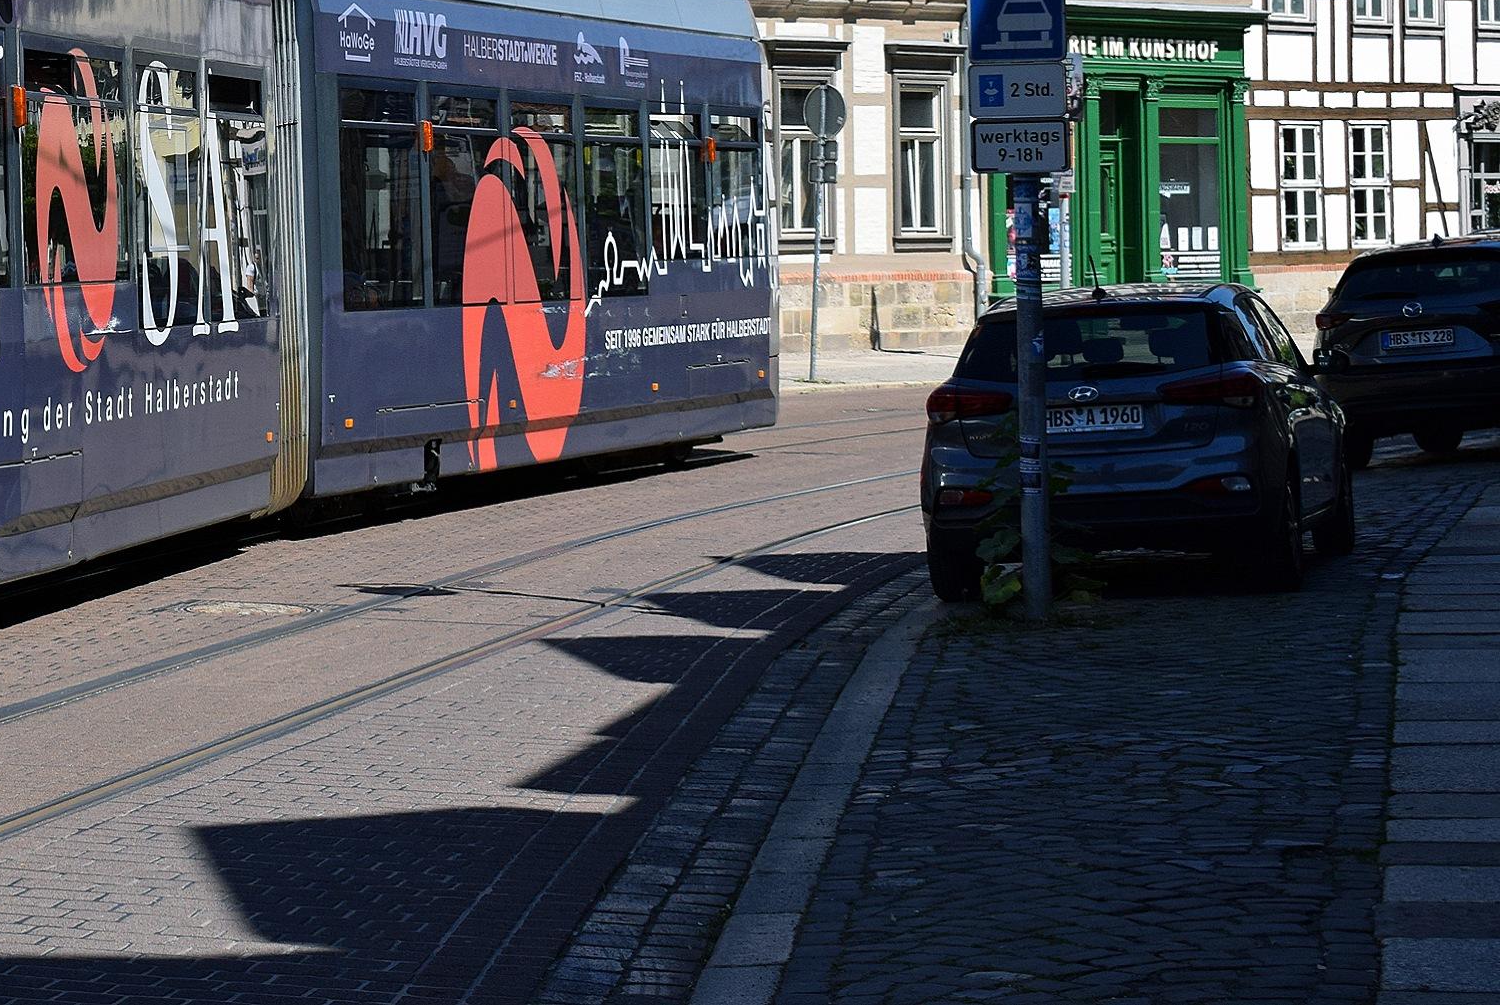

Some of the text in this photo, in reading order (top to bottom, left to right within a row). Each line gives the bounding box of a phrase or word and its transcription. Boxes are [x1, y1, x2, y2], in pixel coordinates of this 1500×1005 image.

[340, 31, 375, 51] HaWoGe
[1101, 36, 1124, 57] IM
[1128, 37, 1219, 60] KUNSTHOF
[1010, 82, 1054, 97] 2 Std.
[980, 128, 1060, 146] werktags
[605, 317, 771, 349] SEIT 1996 GEMEINSAM STARK FÜR HALBERSTADT
[1389, 329, 1453, 346] HBS TS 228
[43, 397, 73, 432] der
[85, 386, 133, 425] Stadt
[145, 370, 239, 414] Halberstadt
[1046, 406, 1141, 428] HBS A 1960
